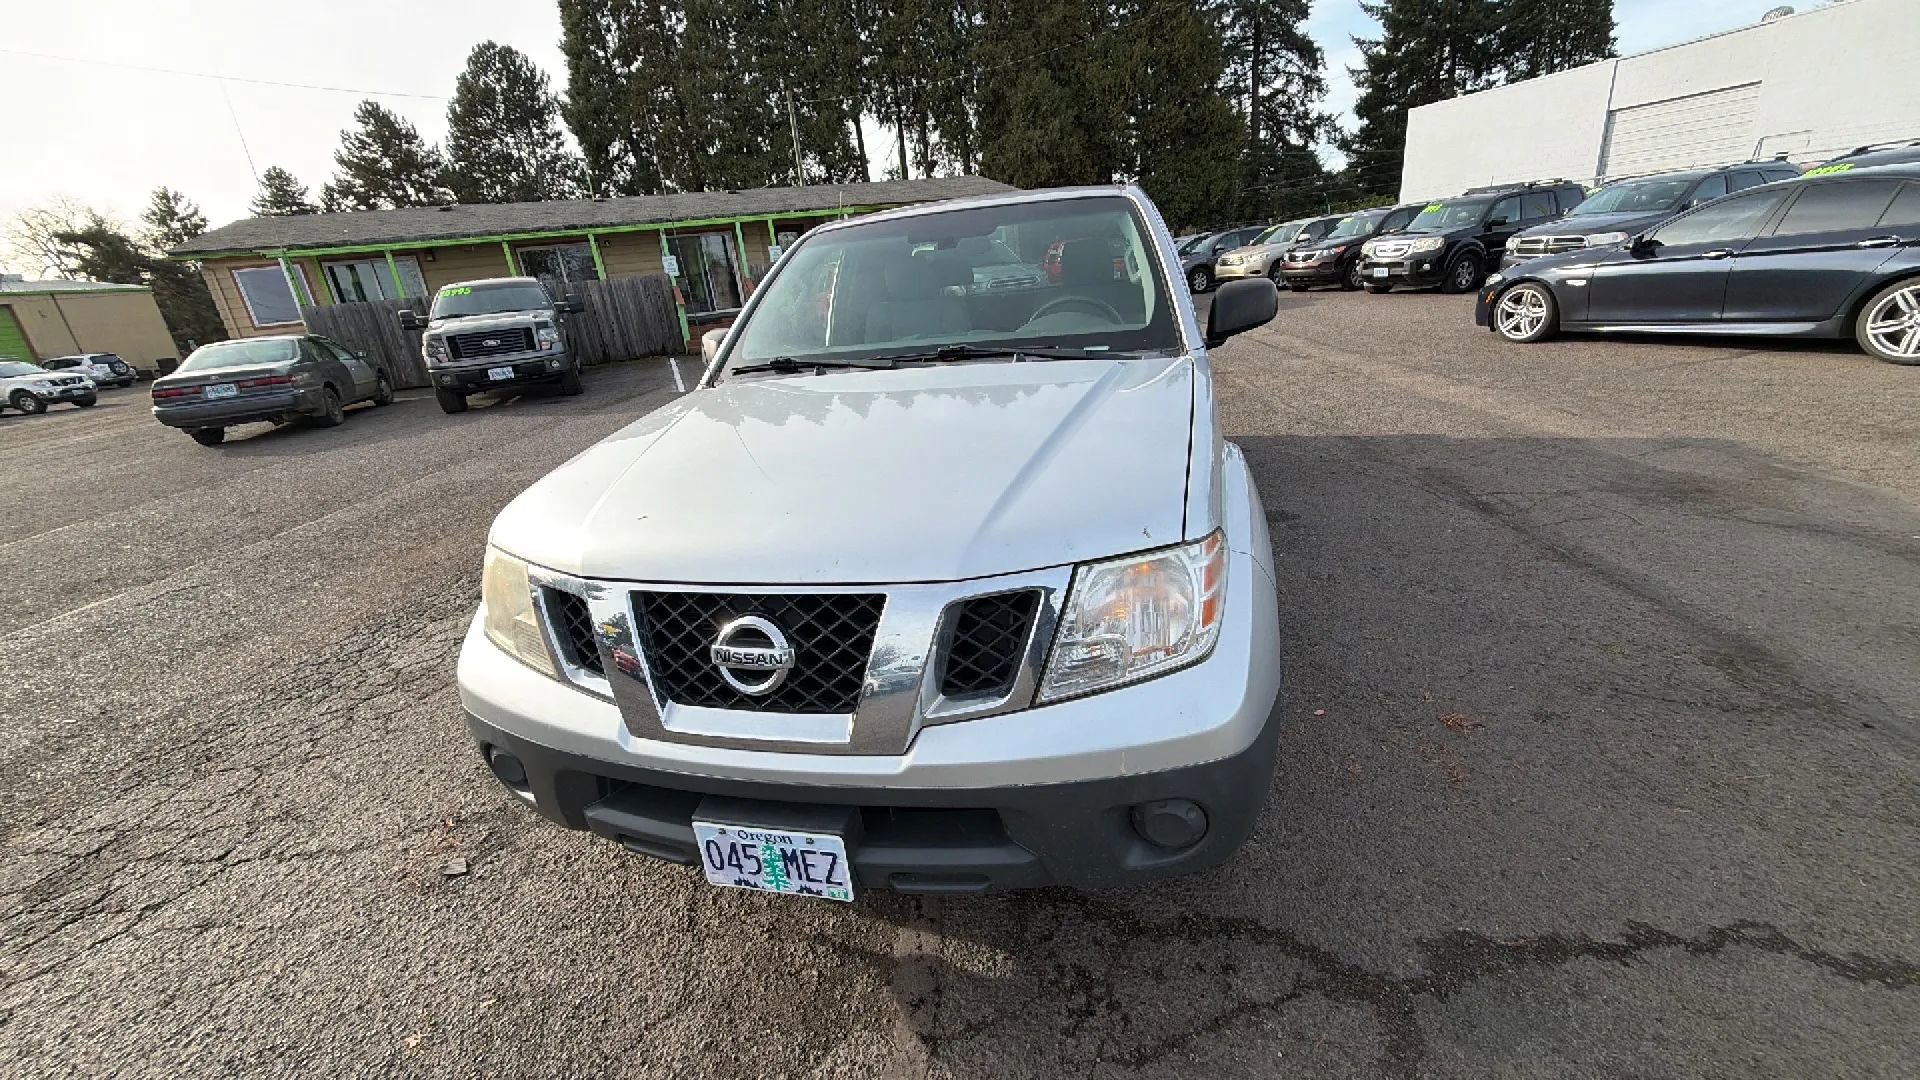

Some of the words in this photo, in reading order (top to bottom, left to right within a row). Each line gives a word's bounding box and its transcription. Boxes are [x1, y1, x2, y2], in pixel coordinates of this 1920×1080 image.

[715, 651, 783, 665] NISSAN
[737, 829, 793, 845] Oregon
[705, 839, 763, 875] 045
[780, 847, 843, 886] MEZ
